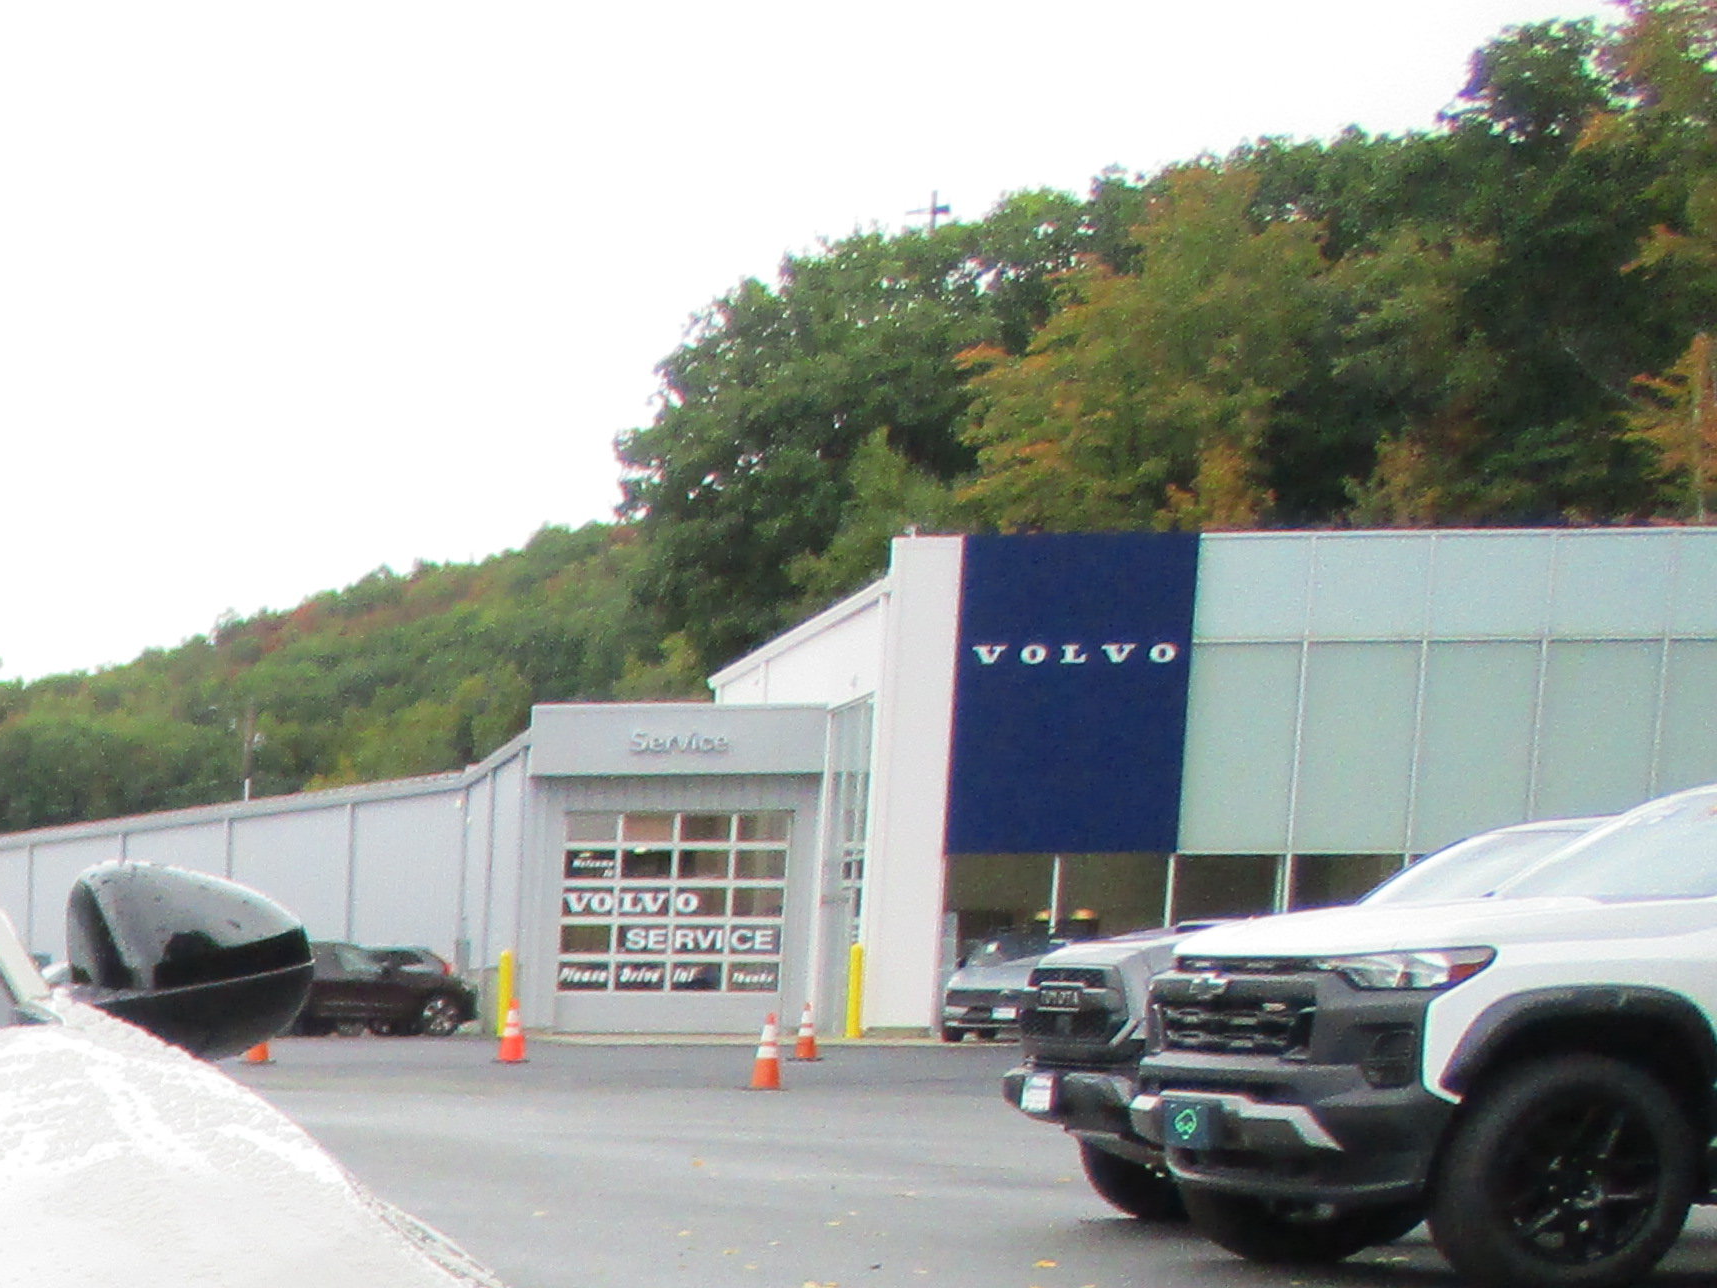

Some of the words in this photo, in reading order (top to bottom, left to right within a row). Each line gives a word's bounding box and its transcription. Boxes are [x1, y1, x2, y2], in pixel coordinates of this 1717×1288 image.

[972, 642, 1179, 665] VOLVO
[630, 729, 729, 753] Service
[564, 891, 699, 913] VOLVO
[625, 928, 774, 950] SERVICE
[560, 966, 608, 983] Please
[618, 966, 664, 983] Drive
